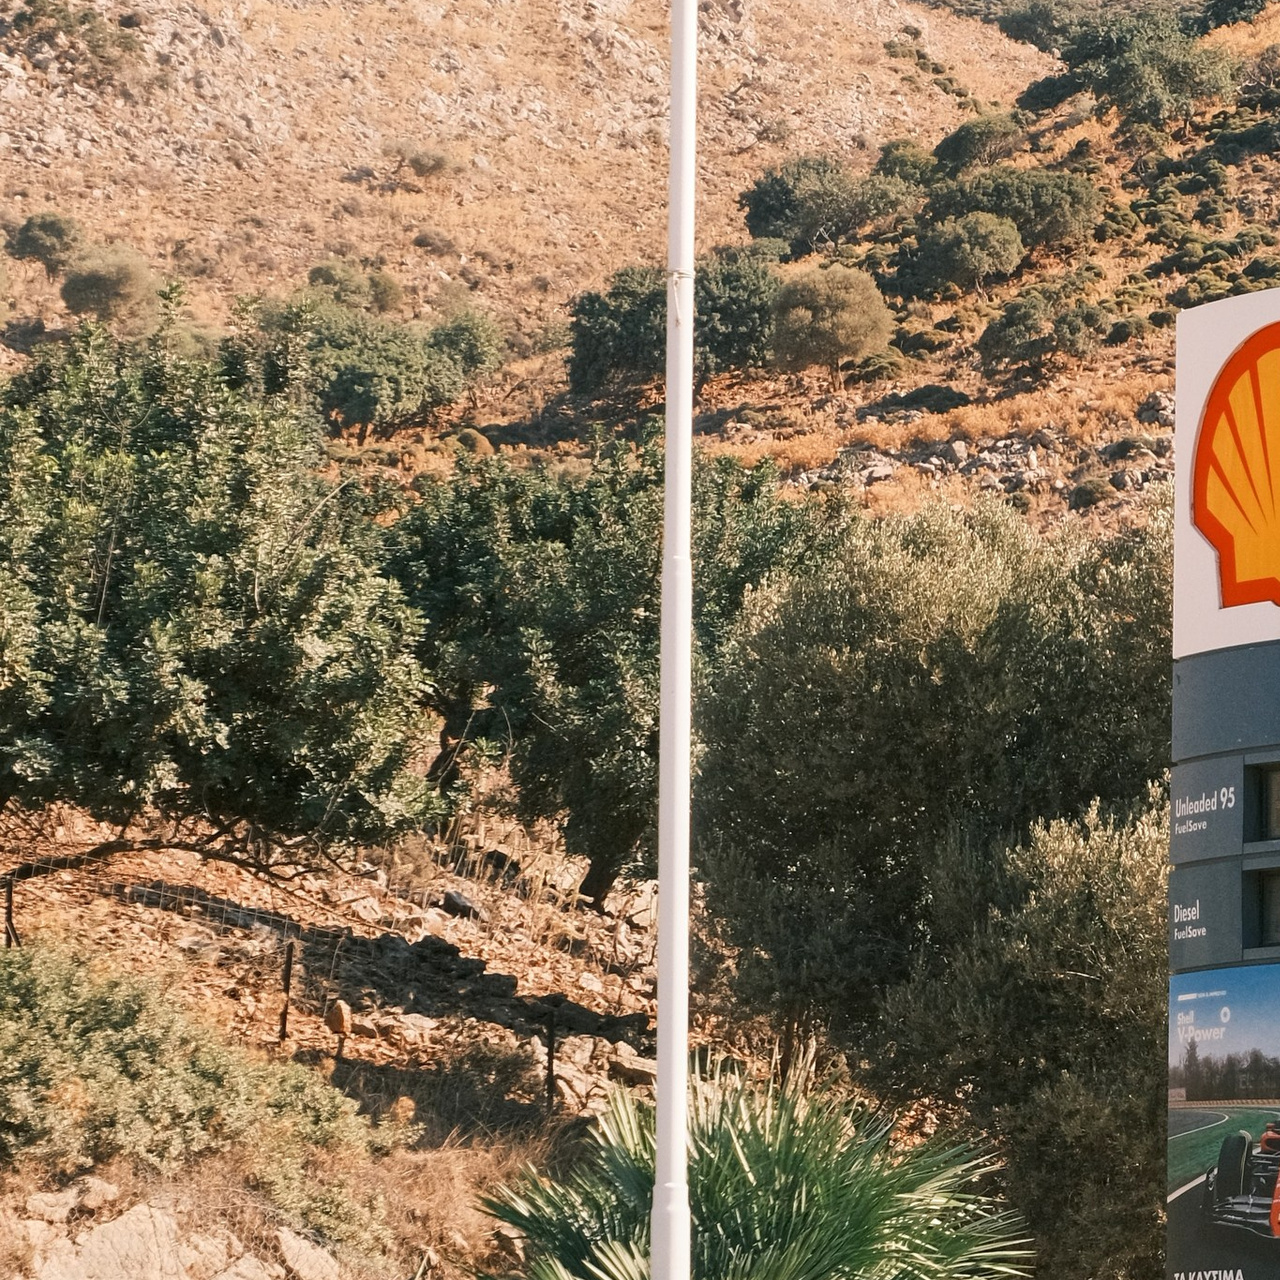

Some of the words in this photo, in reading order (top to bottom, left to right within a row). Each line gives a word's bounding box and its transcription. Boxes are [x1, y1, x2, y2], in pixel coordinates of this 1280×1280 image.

[1175, 790, 1217, 818] Unleaded
[1220, 786, 1236, 809] 95
[1174, 820, 1207, 835] FuelSave
[1174, 899, 1200, 923] Diesel
[1174, 925, 1207, 940] FuelSave
[1177, 1010, 1194, 1025] Shell
[1177, 1026, 1226, 1043] V-Power
